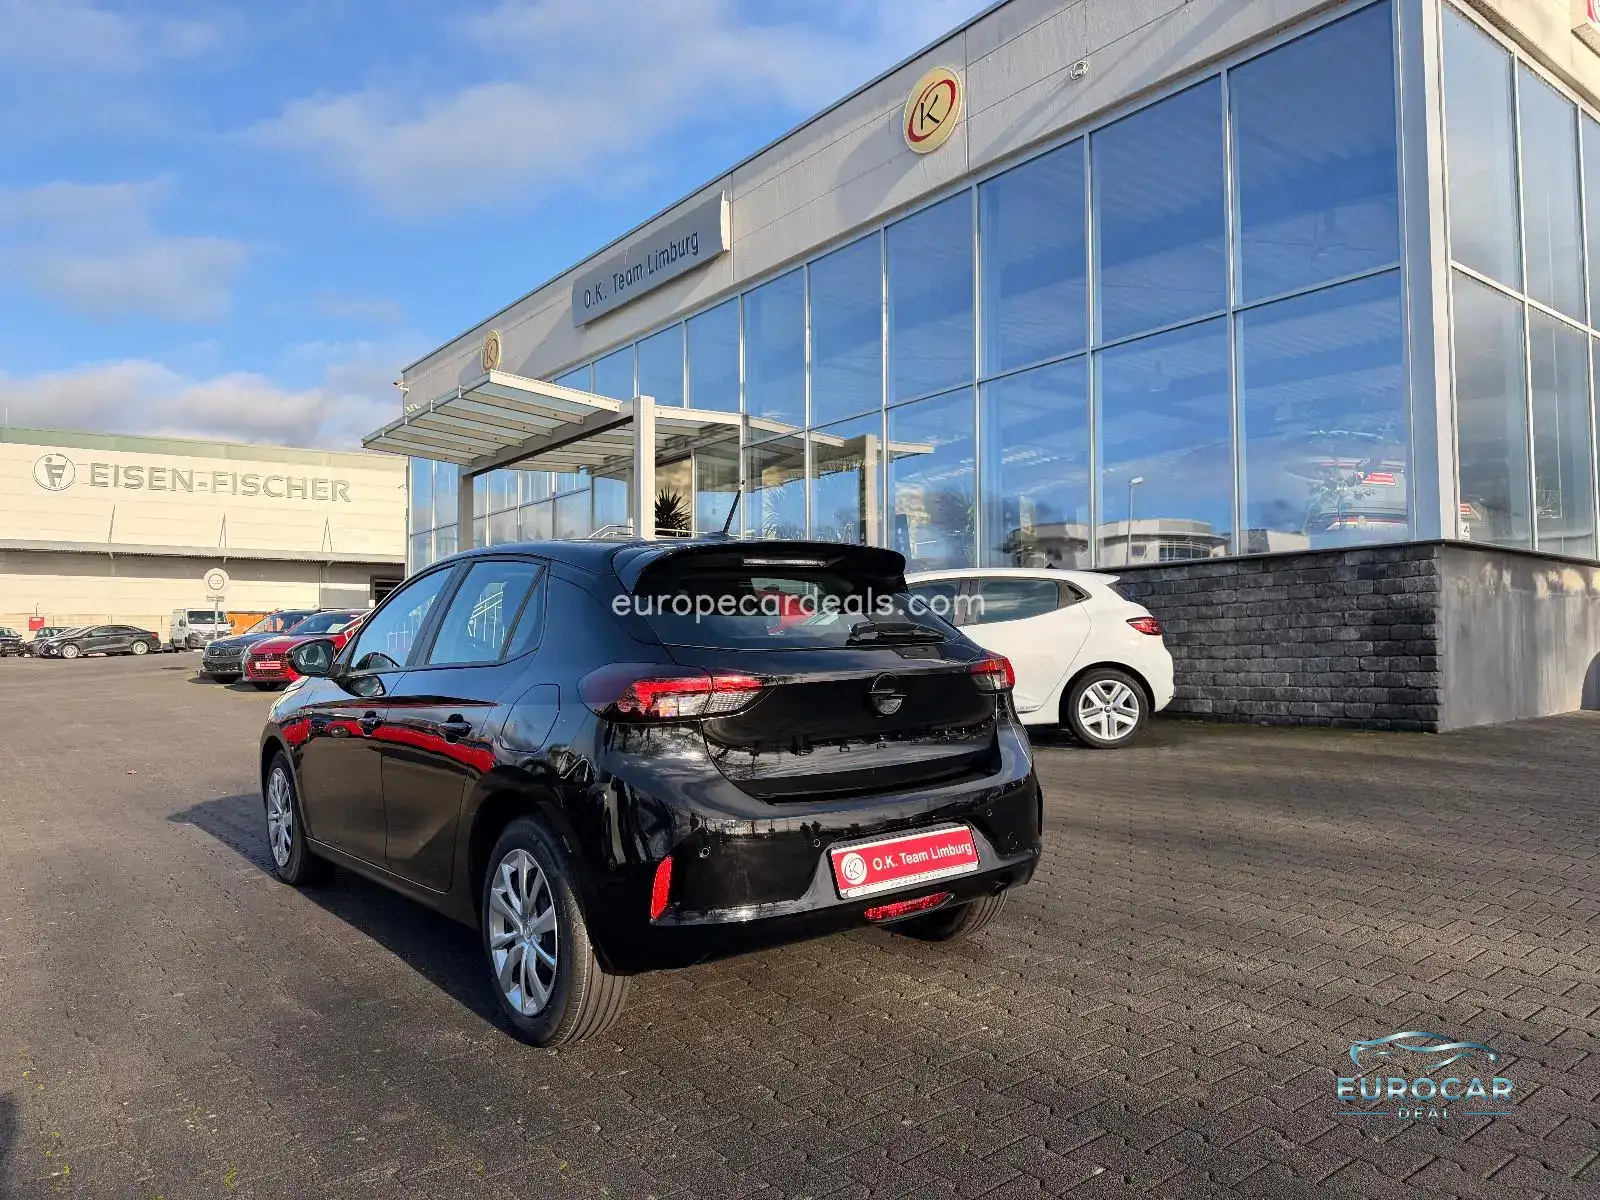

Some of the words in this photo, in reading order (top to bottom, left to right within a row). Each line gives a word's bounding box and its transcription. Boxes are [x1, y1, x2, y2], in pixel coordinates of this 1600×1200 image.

[583, 281, 607, 309] O.K.
[612, 262, 643, 293] Team
[647, 231, 699, 274] Limburg
[89, 462, 351, 502] EISEN-FISCHER
[872, 855, 899, 871] O.K.
[899, 851, 929, 865] Team
[930, 842, 973, 860] Limburg
